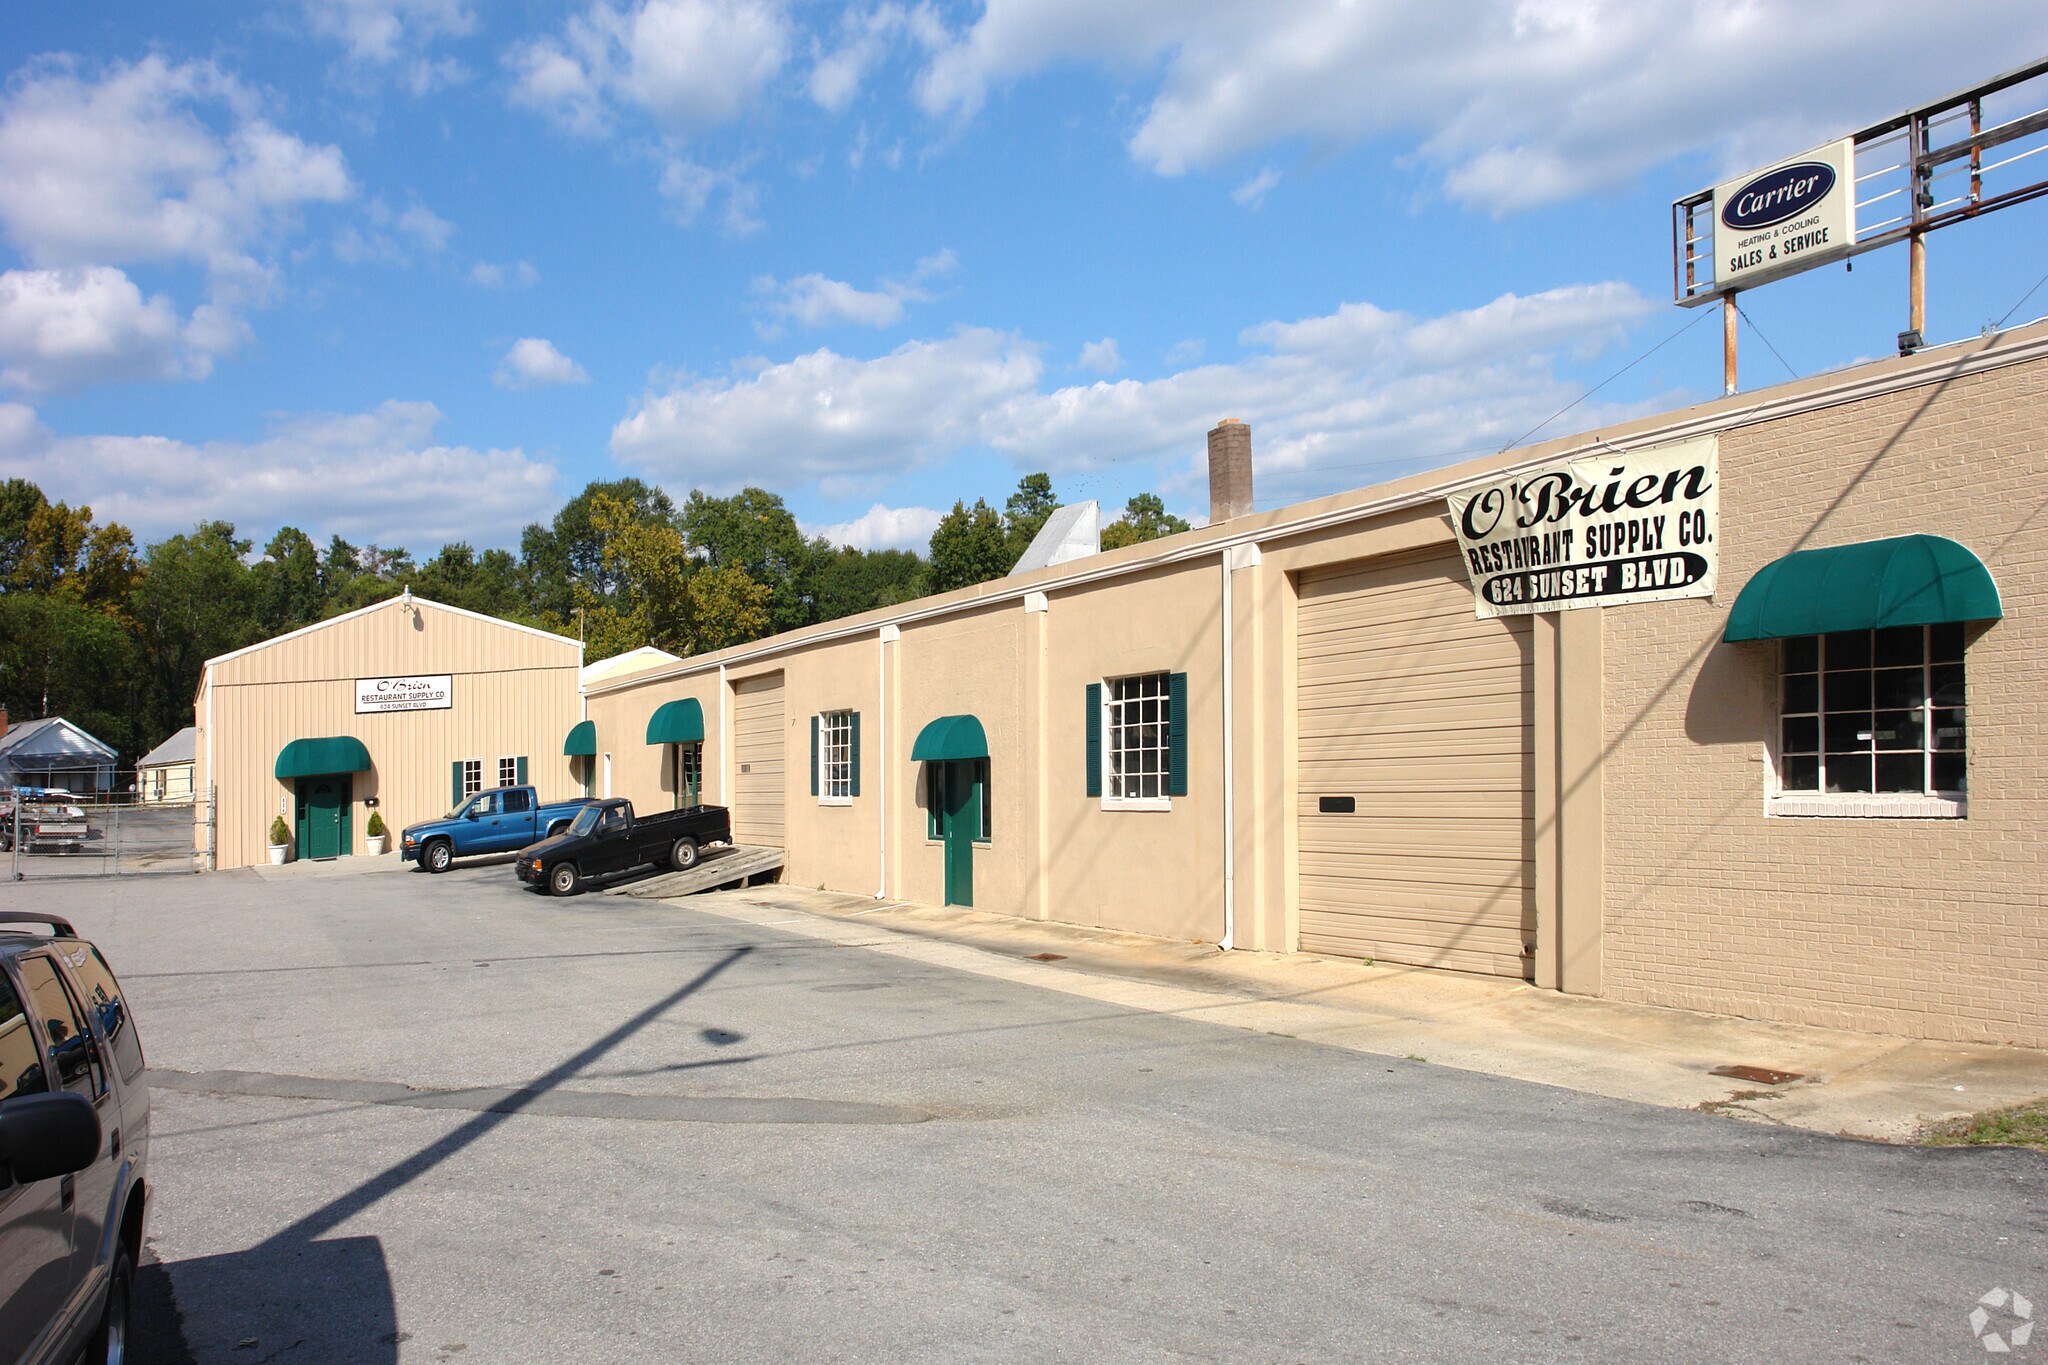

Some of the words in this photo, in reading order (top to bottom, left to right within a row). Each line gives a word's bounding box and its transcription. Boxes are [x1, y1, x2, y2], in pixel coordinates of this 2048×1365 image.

[1737, 173, 1819, 217] Carrier
[1730, 249, 1762, 272] SALES
[1769, 244, 1777, 260] &
[1784, 227, 1829, 255] SERVICE
[1738, 232, 1771, 249] HEATING
[1774, 229, 1779, 238] &
[1782, 216, 1819, 235] COOLING
[1461, 465, 1713, 540] O'Brien
[1467, 528, 1574, 575] RESTAURANT
[1585, 514, 1666, 559] SUPPLY
[1678, 508, 1713, 547] CO.
[1490, 577, 1523, 603] 624
[1529, 565, 1608, 598] SUNSET
[1621, 556, 1694, 590] BLVD.
[361, 693, 407, 702] RESTAURANT
[408, 691, 434, 700] SUPPLY
